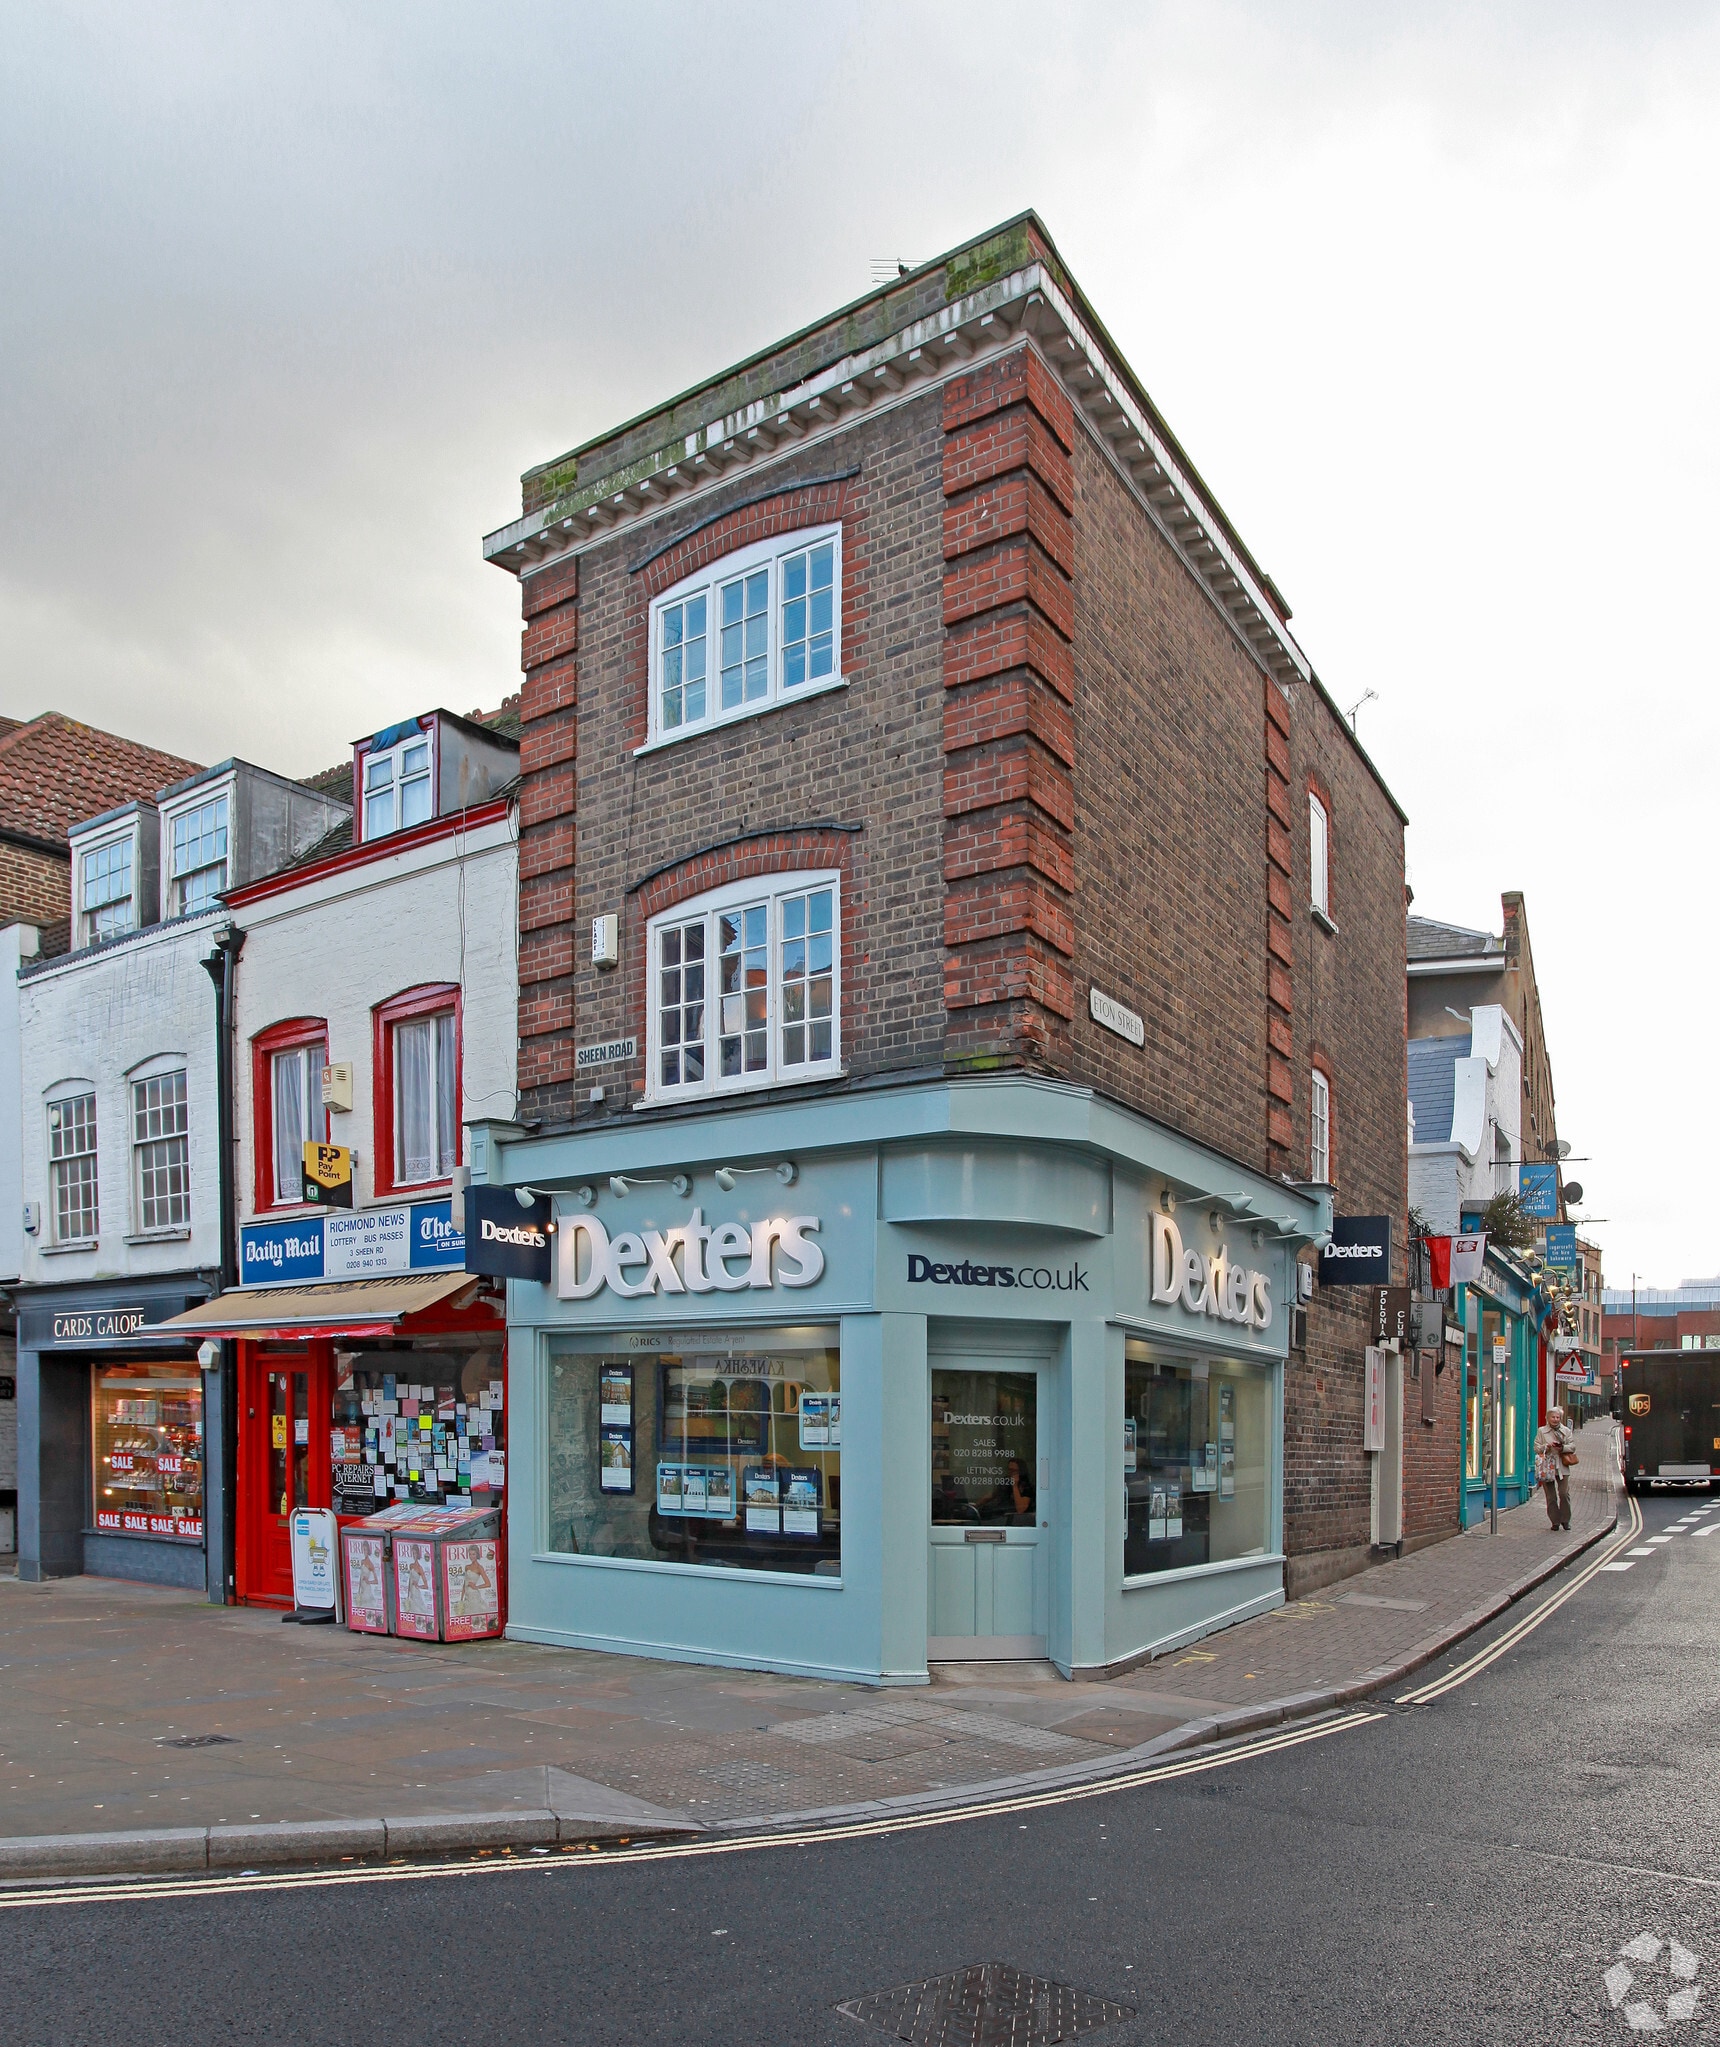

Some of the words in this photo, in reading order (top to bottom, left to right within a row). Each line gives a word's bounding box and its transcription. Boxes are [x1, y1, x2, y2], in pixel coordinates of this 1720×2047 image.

[1093, 996, 1116, 1021] ETON
[1117, 1010, 1142, 1038] STREET
[578, 1046, 607, 1065] SHEEN
[608, 1040, 633, 1059] ROAD
[318, 1161, 333, 1172] Pay
[318, 1169, 341, 1180] Point
[329, 1218, 375, 1234] RICHMOND
[378, 1213, 405, 1228] NEWS
[420, 1217, 453, 1240] The
[330, 1236, 358, 1248] LOTTERY
[364, 1234, 377, 1243] BUS
[379, 1231, 404, 1242] PASSES
[481, 1219, 546, 1248] Dexters
[246, 1237, 283, 1267] Daily
[285, 1234, 320, 1259] Mail
[349, 1249, 354, 1257] 3
[355, 1247, 374, 1256] SHEEN
[375, 1246, 384, 1254] RD
[556, 1207, 825, 1300] Dexters
[1323, 1242, 1383, 1259] Dexters
[346, 1261, 361, 1270] 0208
[362, 1259, 374, 1268] 940
[375, 1258, 388, 1266] 1313
[1150, 1210, 1273, 1330] Dexters
[907, 1254, 1090, 1292] Dexters.co.uk
[1380, 1290, 1389, 1337] POLONIA
[1414, 1304, 1424, 1324] cafe
[54, 1317, 92, 1337] CARDS
[1397, 1311, 1405, 1337] CLUB
[640, 1337, 661, 1346] RICS
[668, 1335, 701, 1347] Regulated
[702, 1335, 722, 1345] Estate
[724, 1335, 745, 1346] Agent
[1556, 1374, 1574, 1382] HIDDEN
[1631, 1400, 1649, 1413] ups
[943, 1411, 1025, 1426] Dexters.co.uk
[973, 1439, 997, 1447] SALES
[953, 1449, 970, 1457] 020
[972, 1449, 993, 1458] 8288
[994, 1449, 1015, 1458] 9988
[111, 1456, 133, 1469] SALE
[158, 1458, 181, 1471] SALE
[332, 1464, 341, 1473] PC
[343, 1464, 374, 1475] REPAIRS
[335, 1472, 371, 1483] INTERNET
[966, 1466, 1004, 1475] LETTINGS
[953, 1477, 970, 1485] 020
[972, 1477, 993, 1485] 8288
[994, 1477, 1015, 1486] 0828
[98, 1514, 120, 1528] SALE
[124, 1516, 148, 1530] SALE
[151, 1518, 174, 1533] SALE
[178, 1521, 202, 1536] SALE
[352, 1608, 366, 1617] FREE
[400, 1612, 415, 1623] FREE
[449, 1616, 471, 1626] FREE
